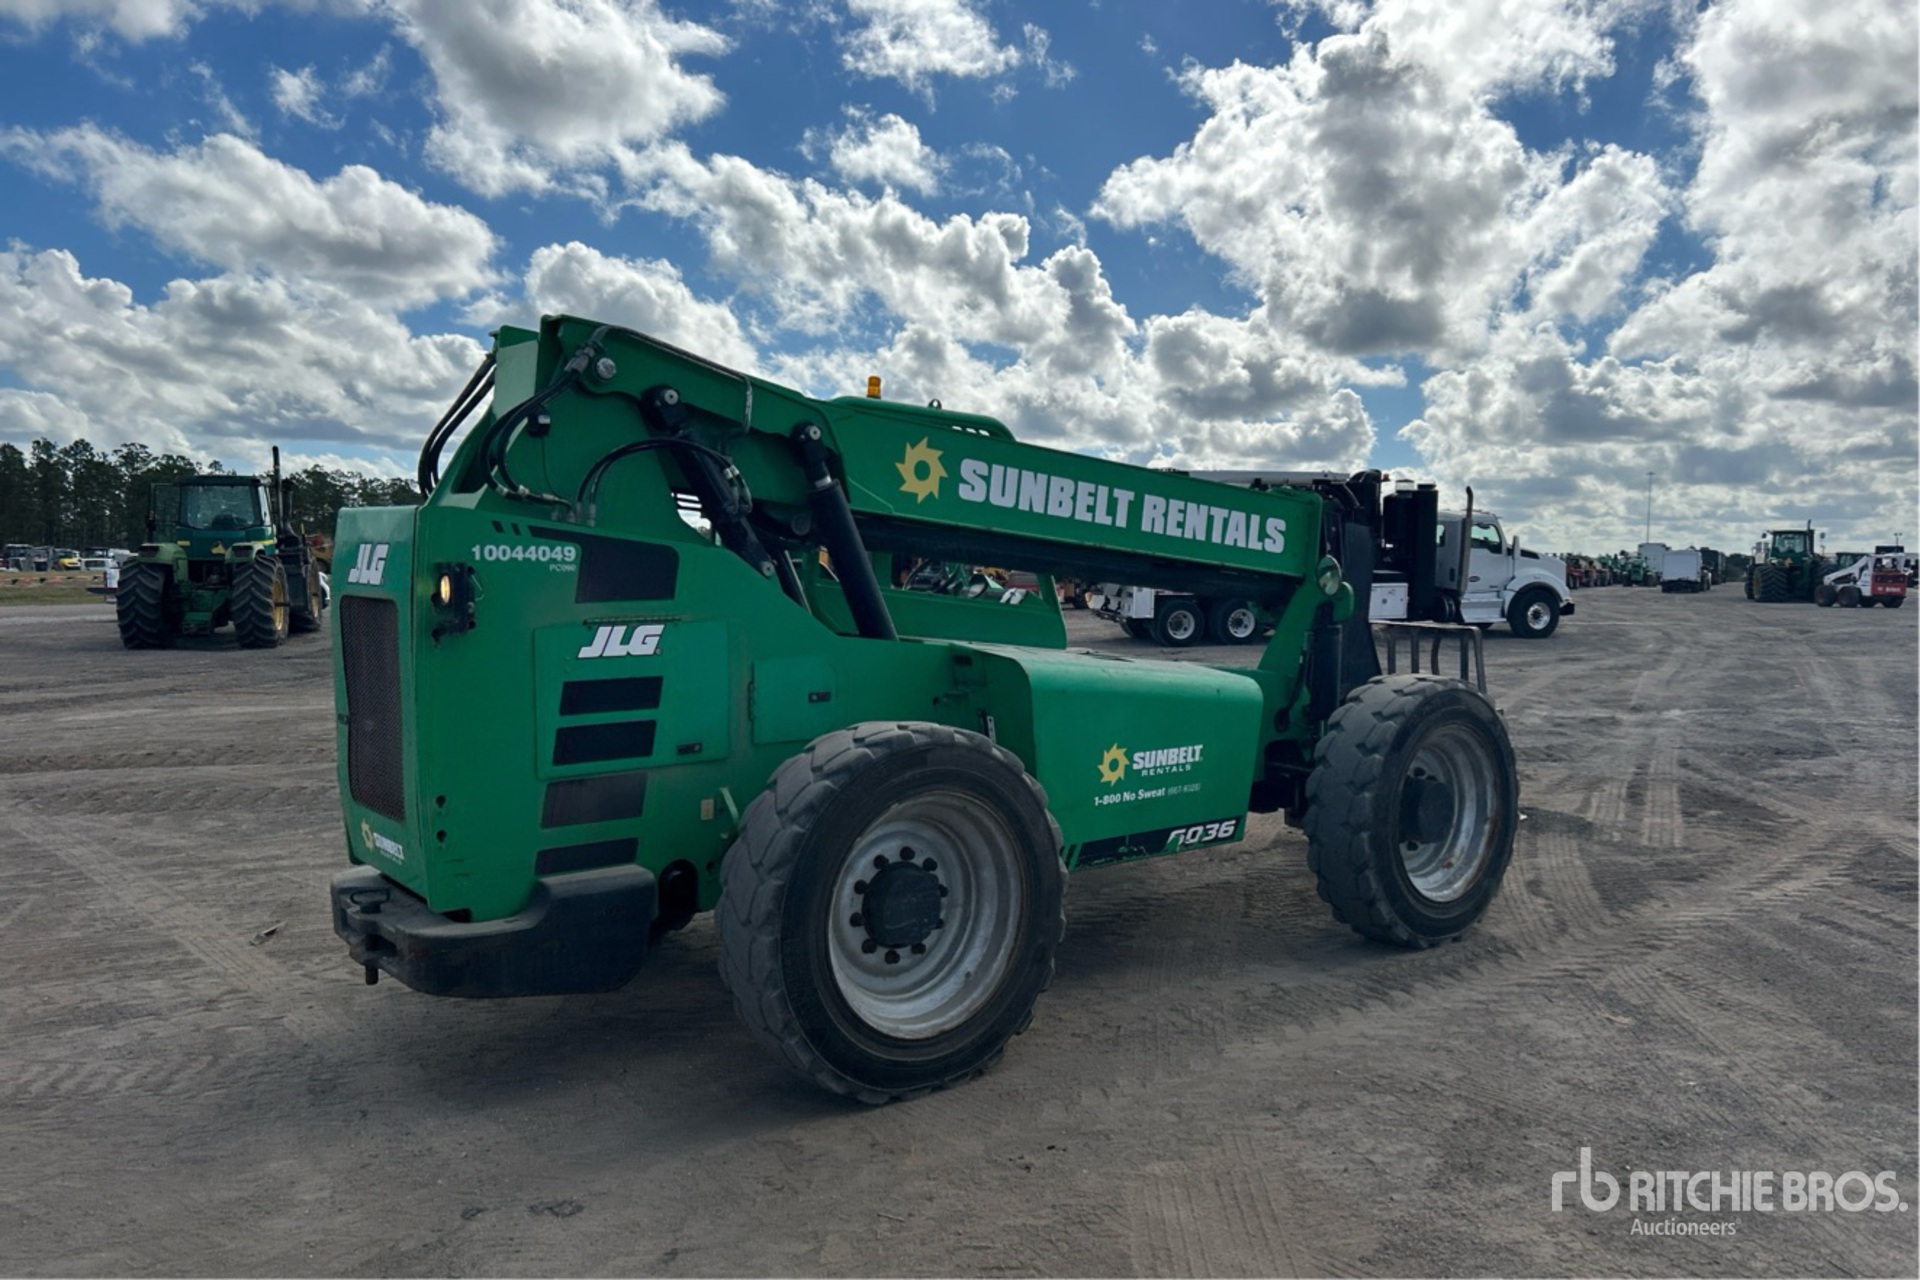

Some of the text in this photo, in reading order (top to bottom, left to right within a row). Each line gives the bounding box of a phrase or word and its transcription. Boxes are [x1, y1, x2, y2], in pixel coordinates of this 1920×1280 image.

[958, 458, 1287, 554] SUNBELT RENTALS
[348, 543, 389, 585] JLG
[472, 544, 577, 562] 10044049
[577, 624, 665, 659] JLG
[1132, 744, 1203, 770] SUNBELT
[1141, 764, 1192, 777] RENTALS
[1094, 793, 1121, 806] 1-800
[1122, 791, 1136, 802] No
[1137, 788, 1166, 800] Sweat
